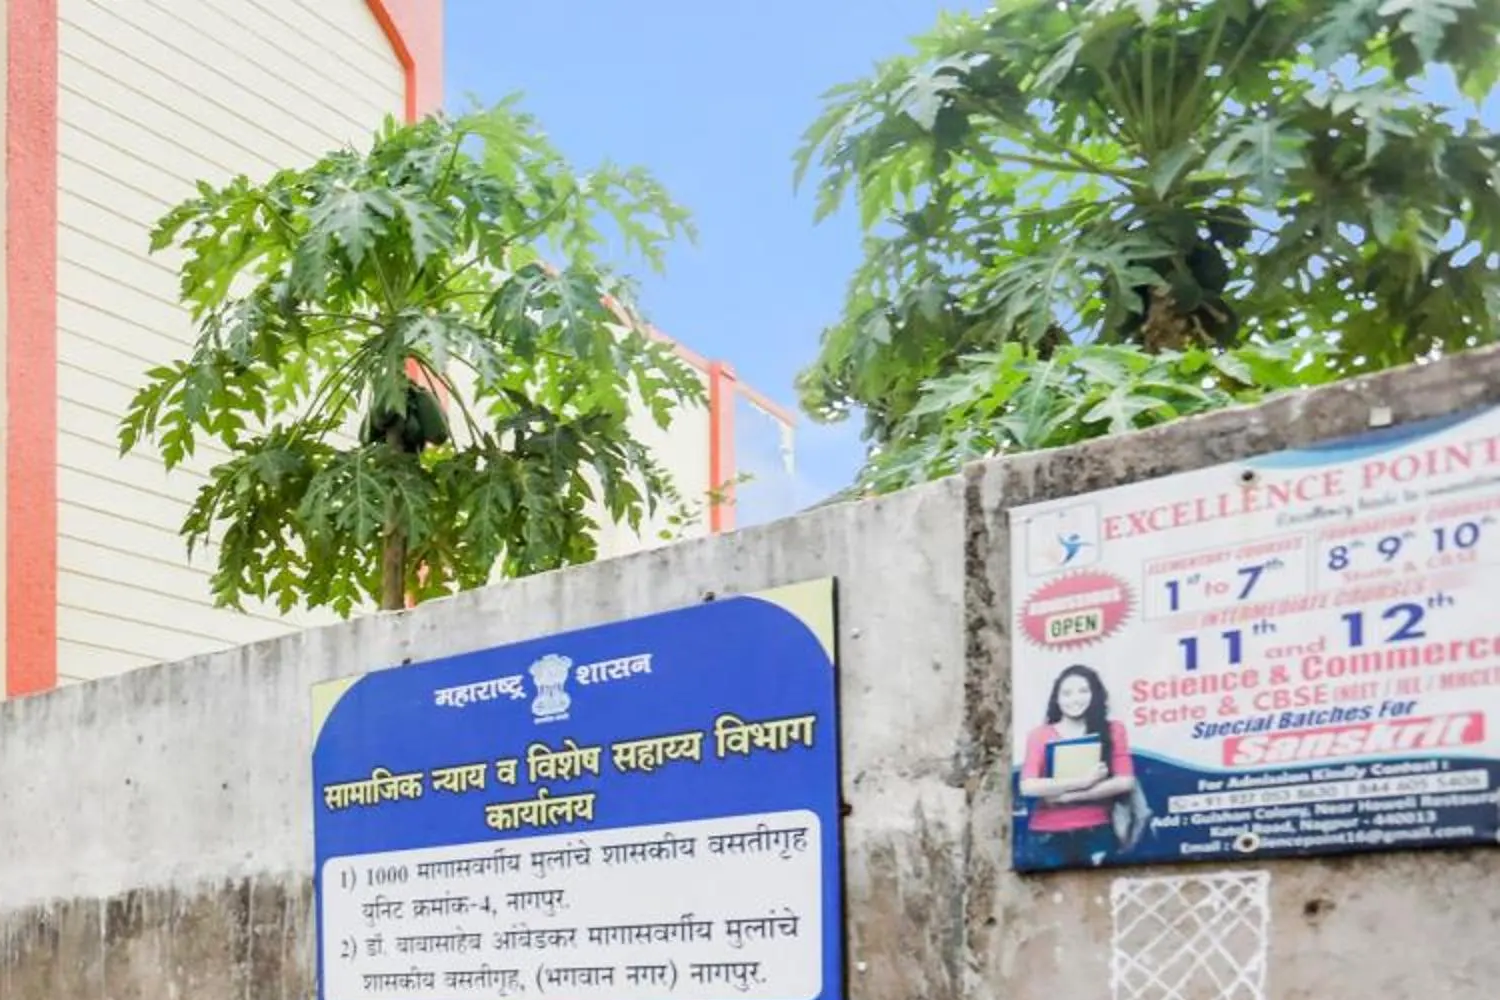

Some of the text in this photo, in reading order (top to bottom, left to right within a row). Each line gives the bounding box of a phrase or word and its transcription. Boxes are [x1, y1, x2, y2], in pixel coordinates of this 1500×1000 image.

[1104, 436, 1500, 540] EXCELLENCE POINT
[1205, 580, 1229, 596] to
[1237, 558, 1284, 599] 7th
[1050, 614, 1099, 638] OPEN
[1179, 592, 1454, 671] 11th and 12th
[434, 653, 653, 709] महाराष्ट्र शासन
[1131, 669, 1259, 703] Science
[1270, 664, 1290, 686] &
[1133, 705, 1207, 727] State
[1218, 696, 1239, 717] &
[1253, 684, 1327, 713] CBSE
[1192, 700, 1418, 740] Special Batches For
[1233, 716, 1474, 766] Sanskrit
[323, 714, 817, 811] सामाजिक न्याय व विशेष सहाय्य विभाग
[1198, 778, 1224, 792] For
[1226, 770, 1310, 789] Admission
[485, 789, 596, 833] कार्यालय
[1300, 817, 1359, 834] Nagpur
[1314, 802, 1354, 815] Near
[341, 865, 358, 892] 1)
[366, 866, 409, 887] 1000
[530, 839, 592, 879] मुलांचे
[601, 831, 697, 867] शासकीय
[707, 823, 809, 860] वसतीगृह
[361, 894, 405, 928] युनिट
[340, 934, 358, 961] 2)
[588, 911, 714, 946] मागासवर्गीय
[724, 906, 800, 949] मुलांचे
[362, 964, 436, 992] शासकीय
[535, 961, 616, 993] (भगवान
[626, 960, 678, 991] नगर)
[690, 961, 768, 992] नागपुर.
